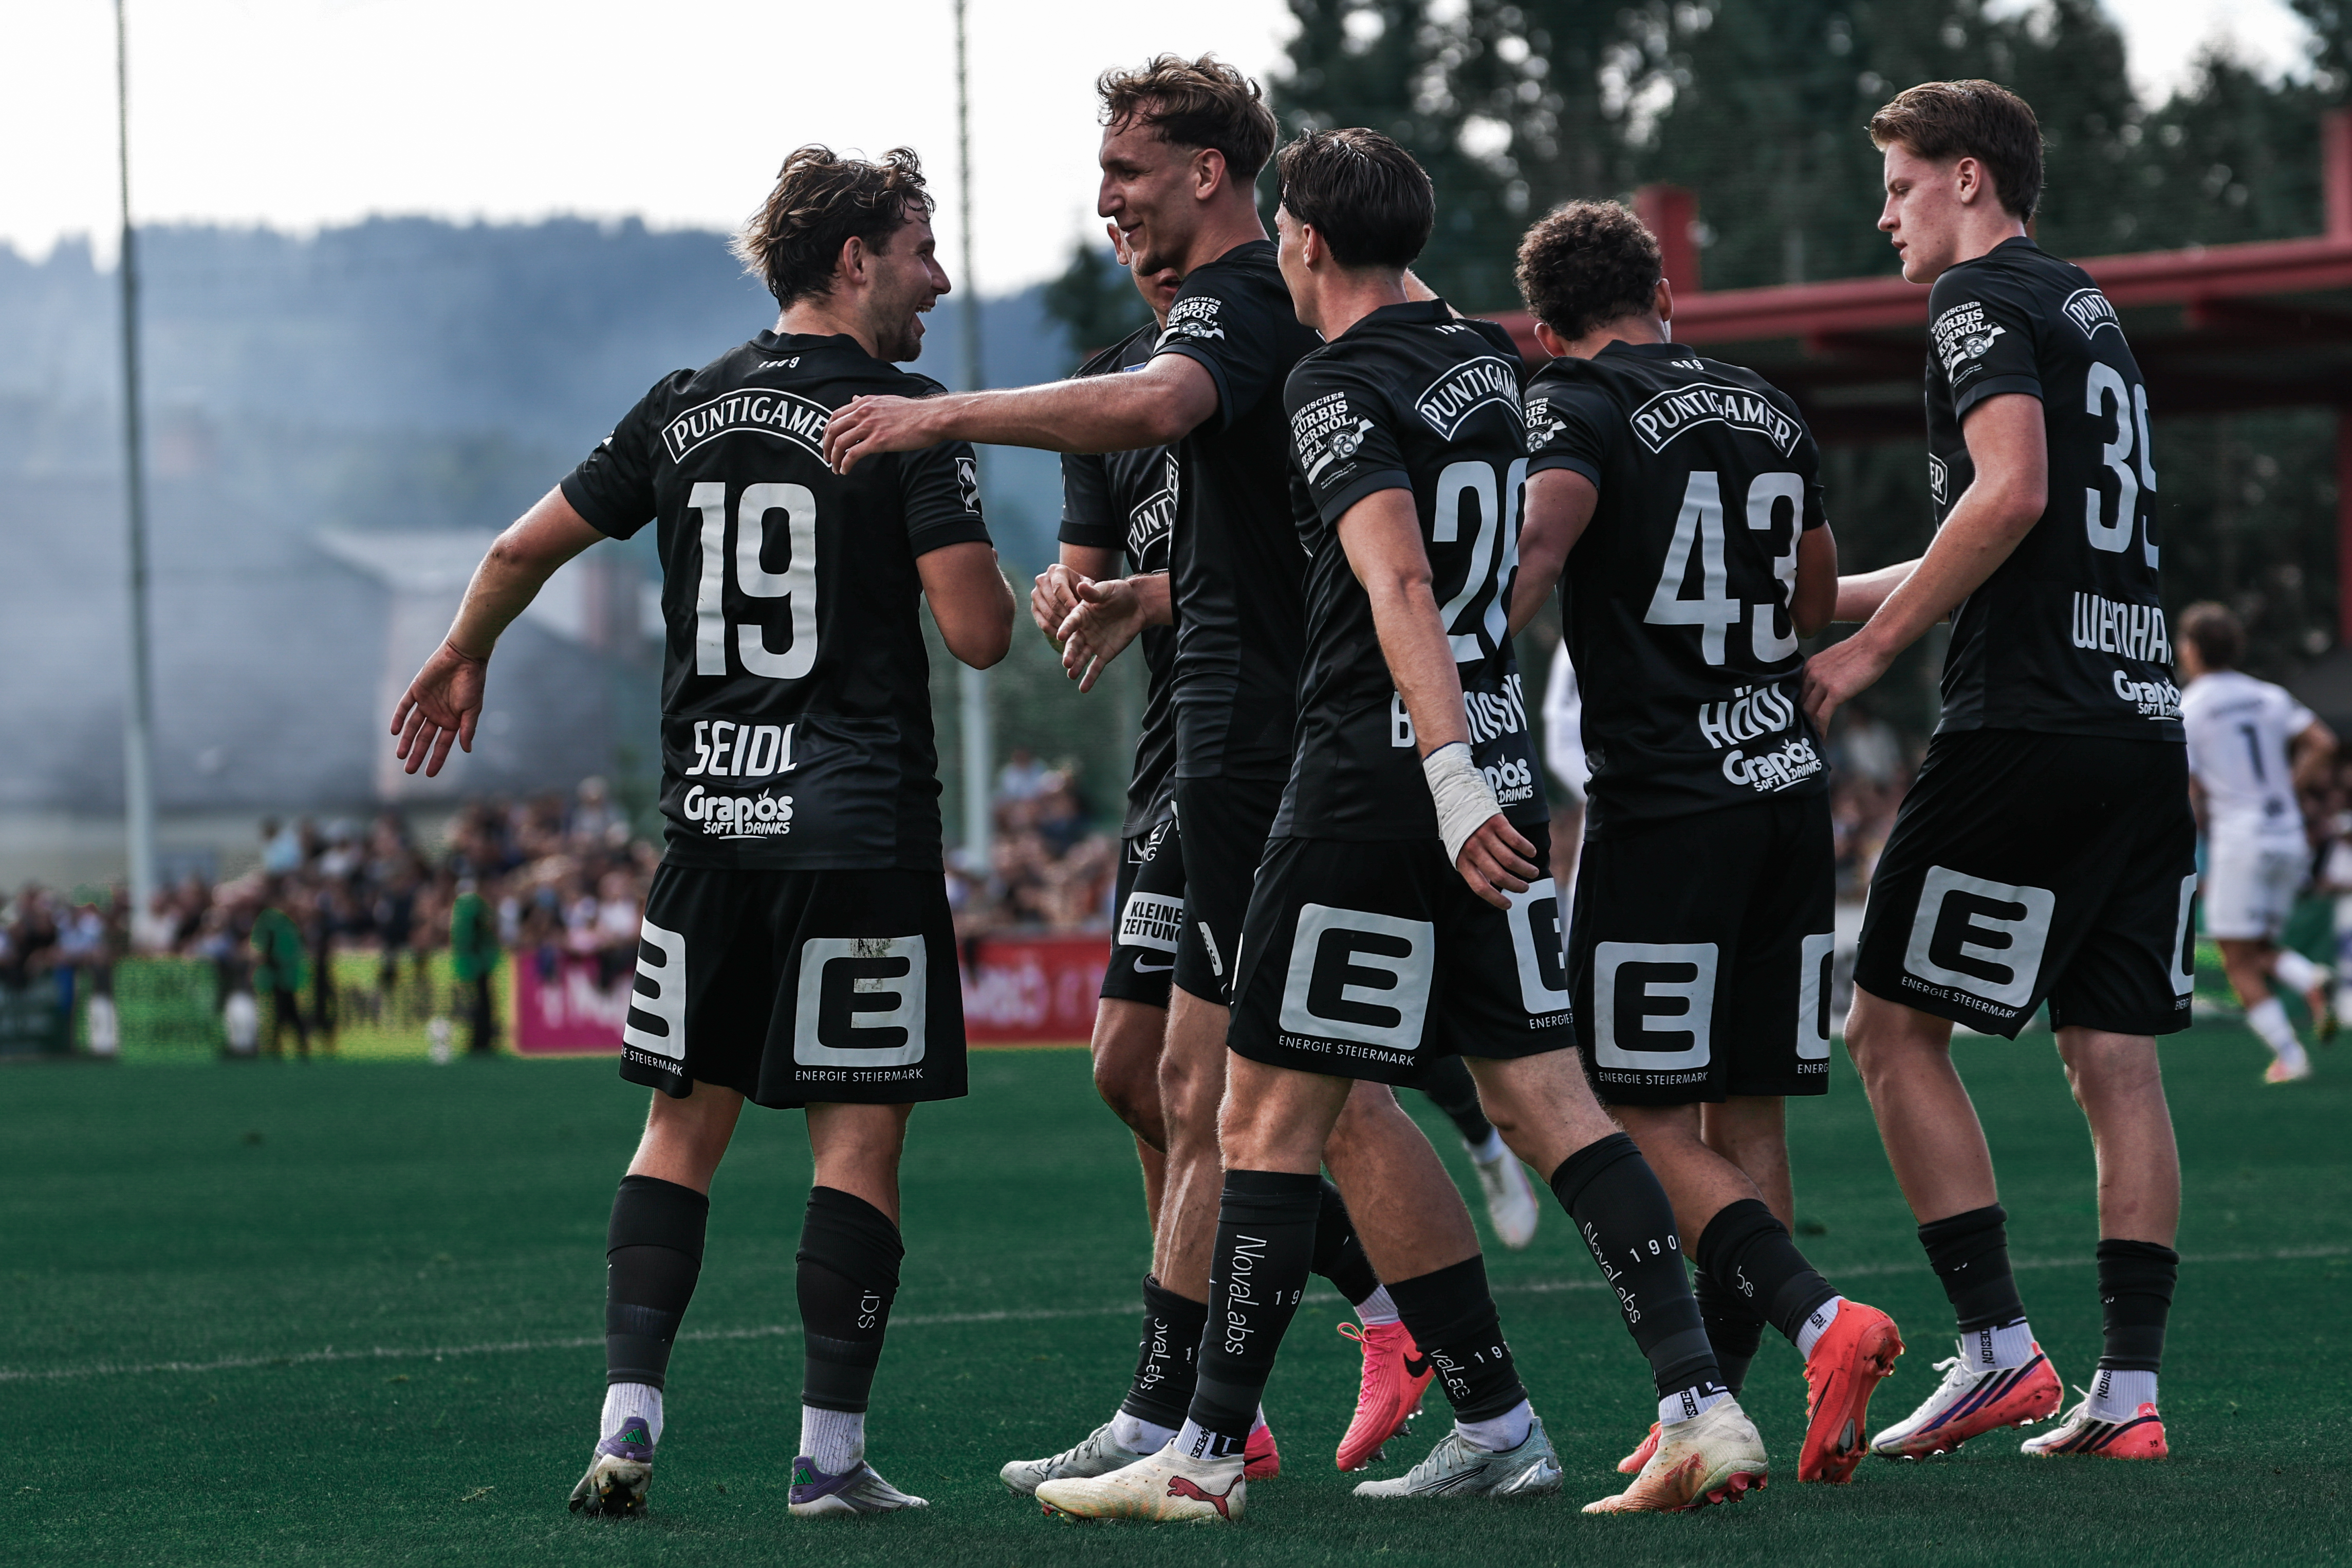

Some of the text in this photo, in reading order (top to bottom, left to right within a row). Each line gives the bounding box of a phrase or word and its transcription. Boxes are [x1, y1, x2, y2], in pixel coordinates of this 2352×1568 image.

[1931, 301, 1980, 334] STEIRISCHES
[1935, 308, 1985, 344] KÜRBIS
[672, 396, 830, 452] PUNTIGAME
[1291, 391, 1345, 427] STEIRISCHES
[1294, 400, 1348, 442] KÜRBIS
[1636, 390, 1790, 448] PUNTIGAMER
[688, 482, 818, 679] 19
[1644, 471, 1804, 665] 43
[1699, 682, 1796, 749] HÖDL
[2138, 702, 2158, 715] SOFT
[685, 720, 798, 777] SEIDL
[1754, 759, 1822, 792] SOFT DRINKS
[1498, 785, 1533, 804] DRINKS
[702, 821, 790, 835] SOFT DRINKS
[1131, 902, 1183, 925] KLEINE
[1902, 976, 2019, 1019] ENERGIE STEIERMARK
[629, 1050, 683, 1077] STEIERMARK
[1279, 1035, 1415, 1066] ENERGIE STEIERMARK
[795, 1068, 923, 1081] ENERGIE STEIERMARK
[1599, 1072, 1708, 1085] ENERGIE STEIERMARK
[1225, 1235, 1267, 1355] NovaLabs
